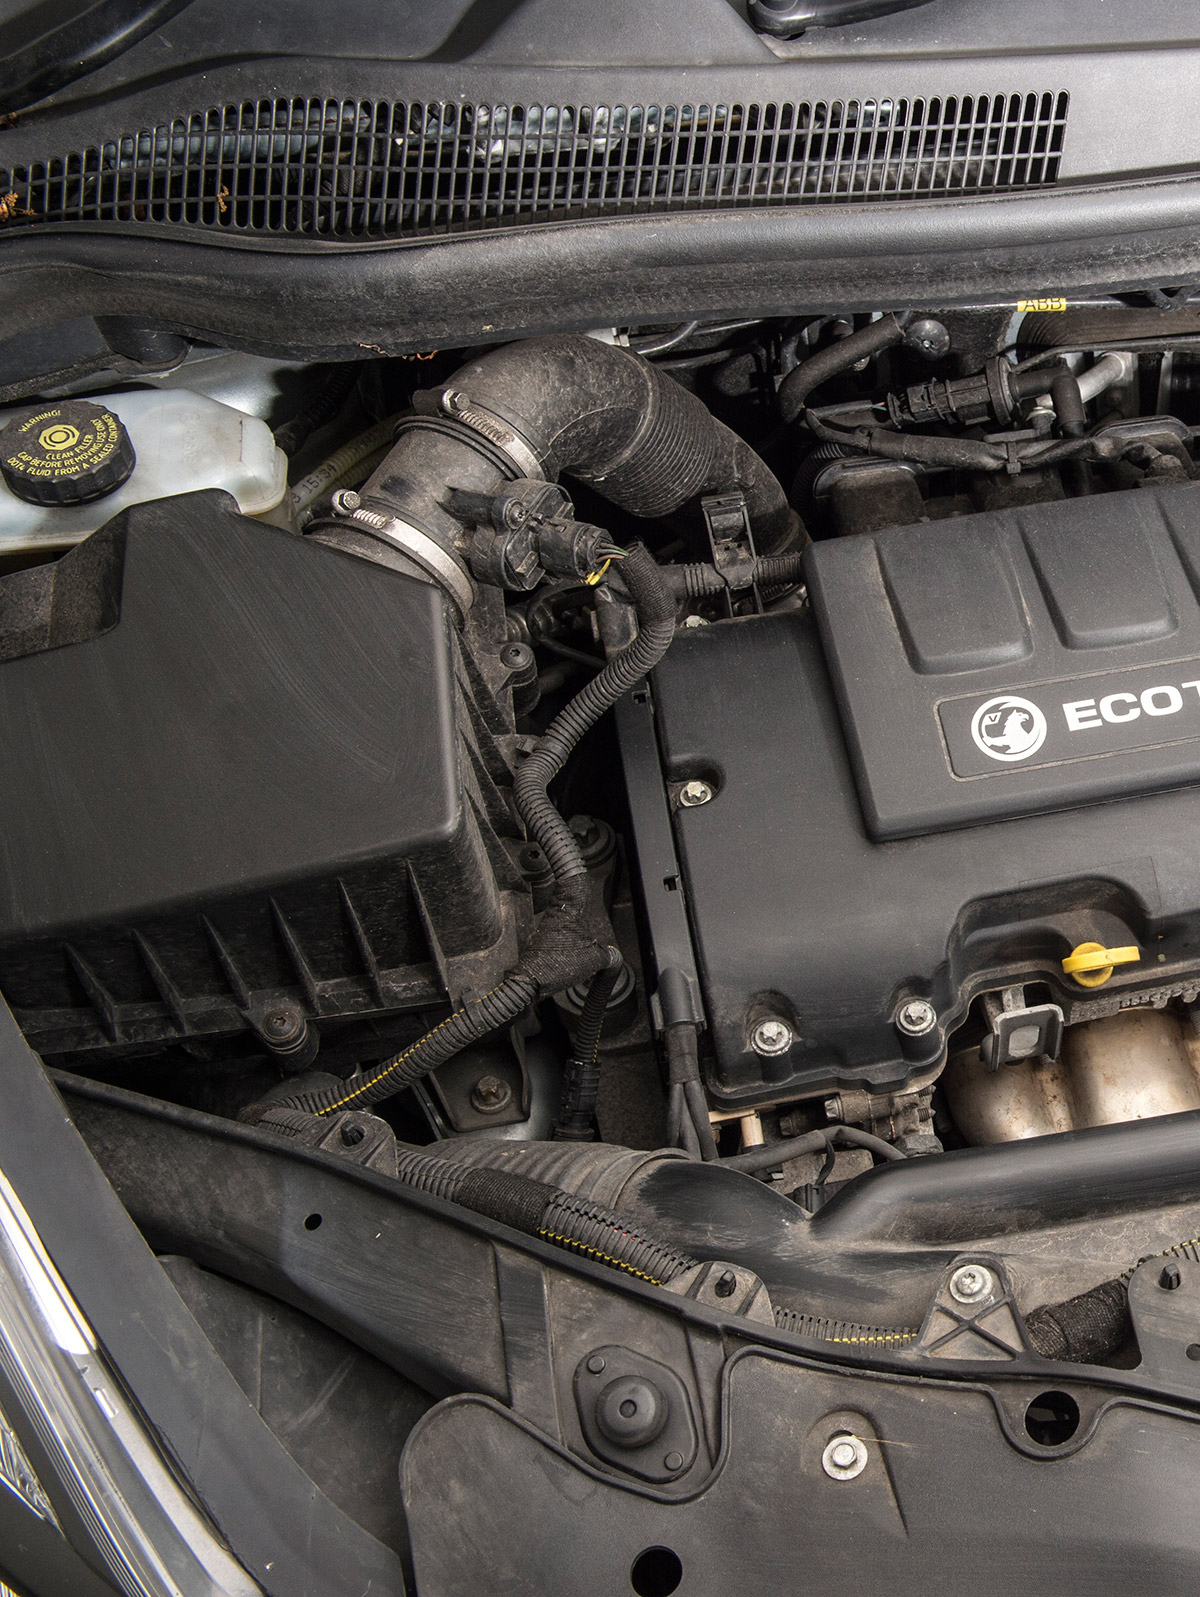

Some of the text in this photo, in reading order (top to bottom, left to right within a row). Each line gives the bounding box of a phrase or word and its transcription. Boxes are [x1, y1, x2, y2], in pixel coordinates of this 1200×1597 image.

[1023, 298, 1062, 311] ABB
[18, 410, 61, 432] WARNING!
[7, 414, 118, 476] DOT4 FLUID FROM A SEALED CONTAINER
[46, 434, 94, 460] CLEAN FILLER
[18, 451, 32, 462] CAP
[30, 460, 62, 468] BEFORE
